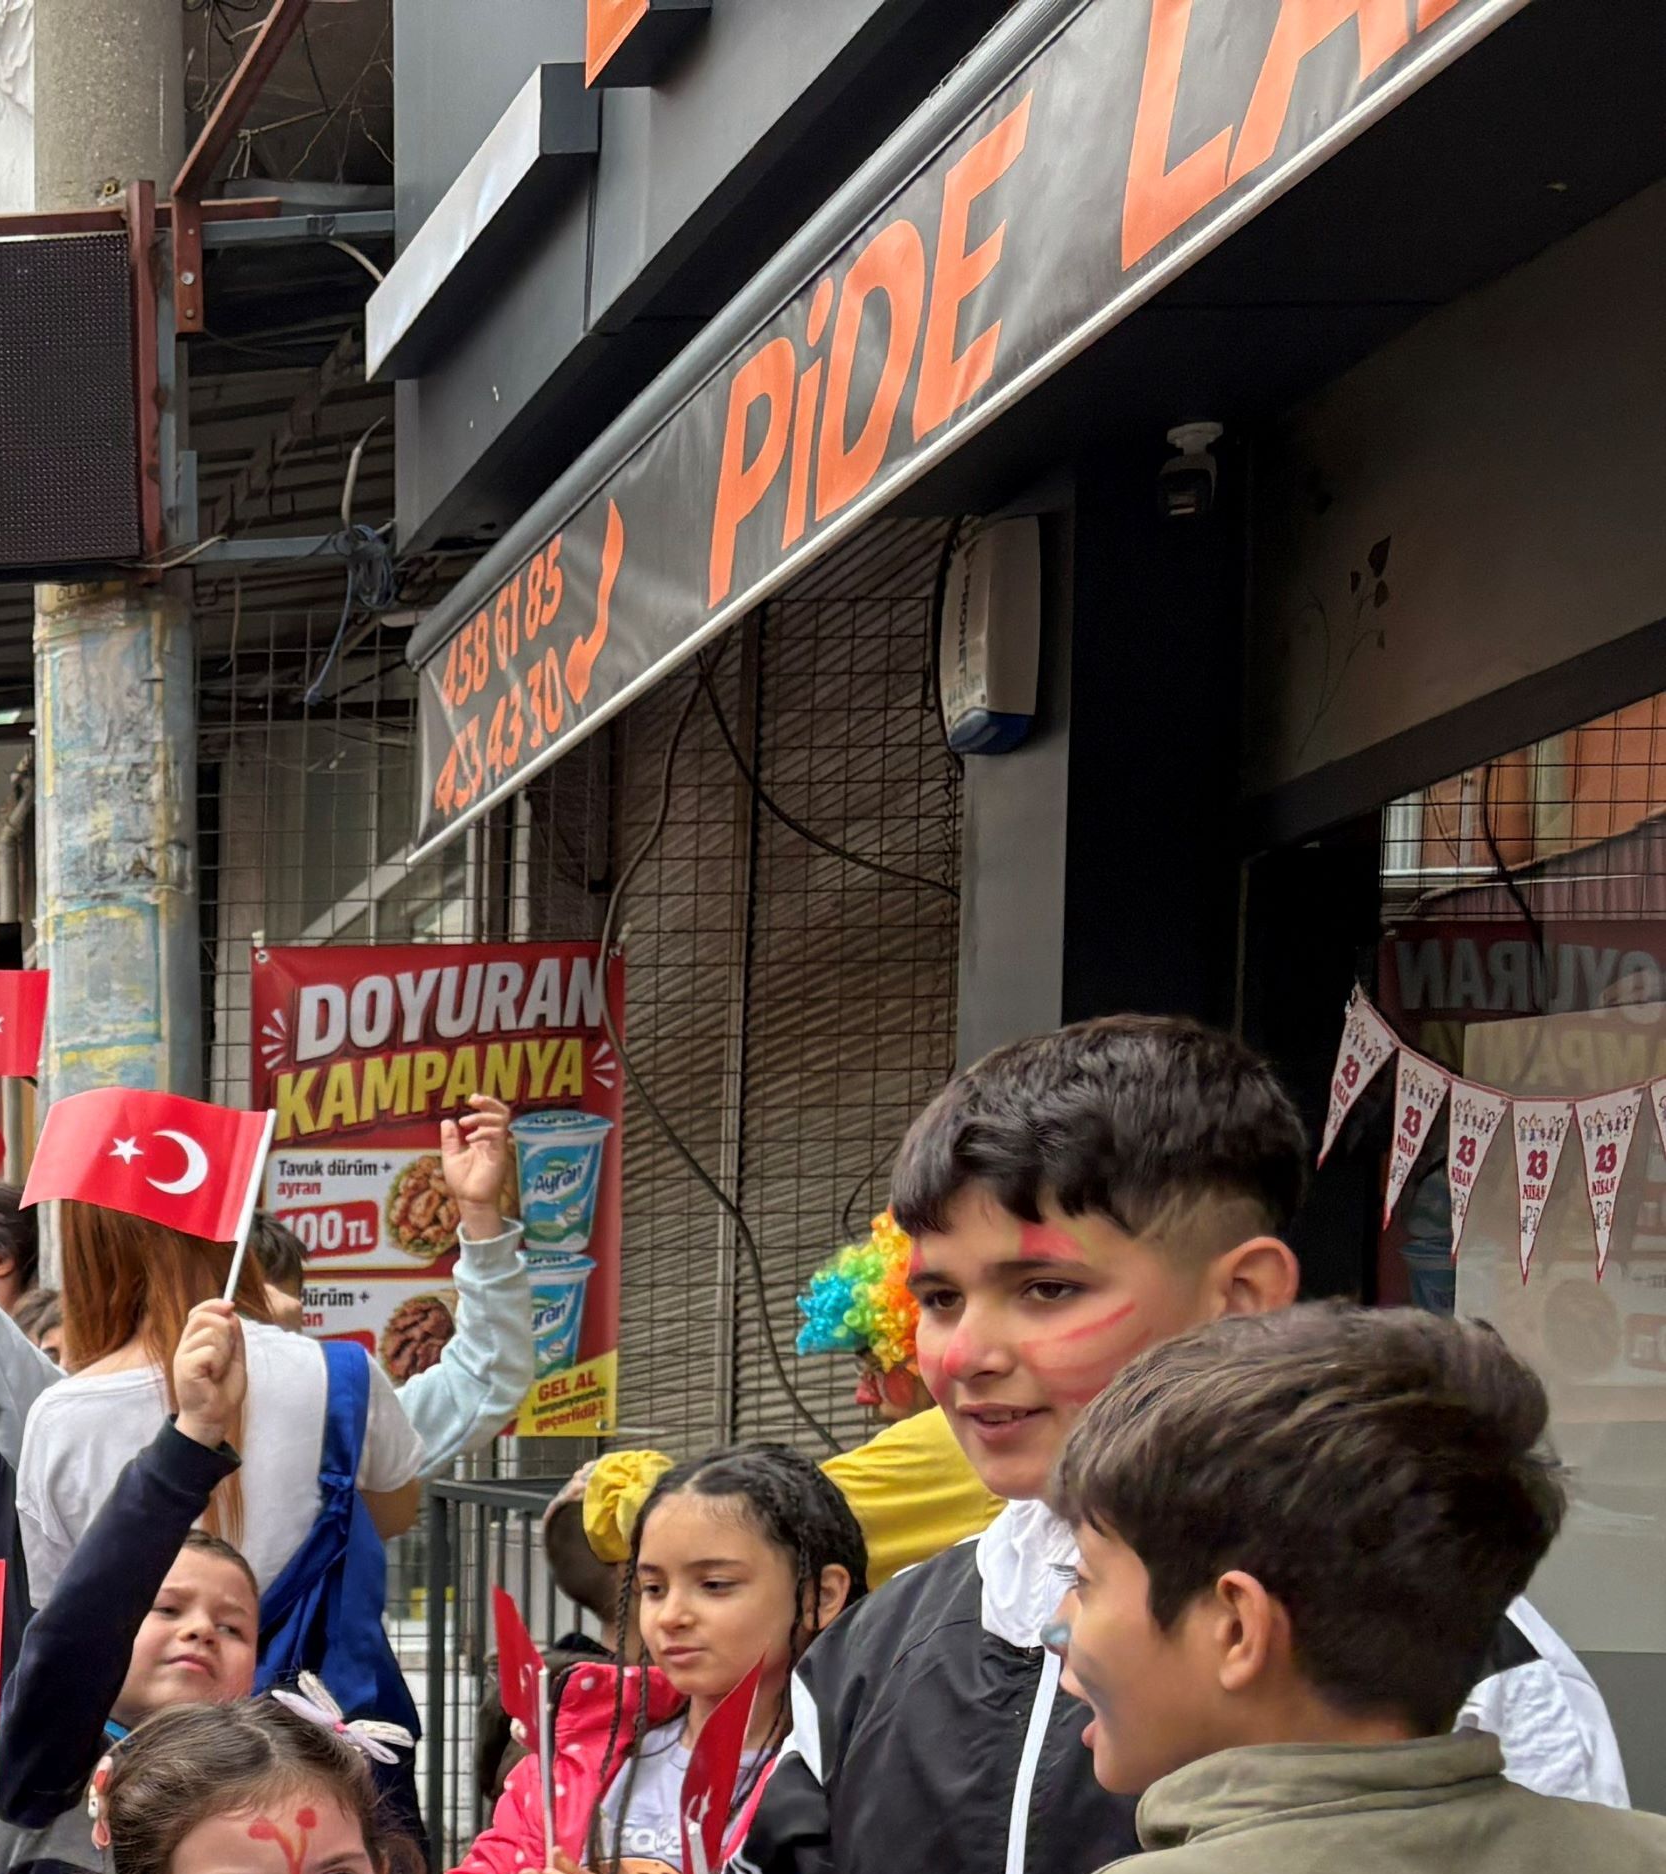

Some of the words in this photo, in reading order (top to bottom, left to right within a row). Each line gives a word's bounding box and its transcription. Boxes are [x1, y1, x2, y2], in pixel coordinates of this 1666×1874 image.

[1121, 0, 1461, 272] LA
[442, 610, 489, 713] 458
[495, 574, 521, 671] 61
[525, 531, 563, 641] 85
[527, 646, 563, 749] 30
[296, 957, 605, 1062] DOYURAN
[1341, 1054, 1360, 1088] 23
[274, 1038, 584, 1140] KAMPANYA
[1402, 1105, 1422, 1138] 23
[278, 1160, 323, 1176] Tavuk
[327, 1159, 378, 1176] dürüm
[1456, 1135, 1477, 1167] 23
[1526, 1150, 1549, 1180] 23
[1594, 1143, 1617, 1173] 23
[276, 1182, 322, 1198] ayran
[534, 1164, 583, 1195] Ayran
[345, 1220, 374, 1247] TL
[538, 1377, 570, 1402] GEL
[574, 1369, 597, 1391] AL
